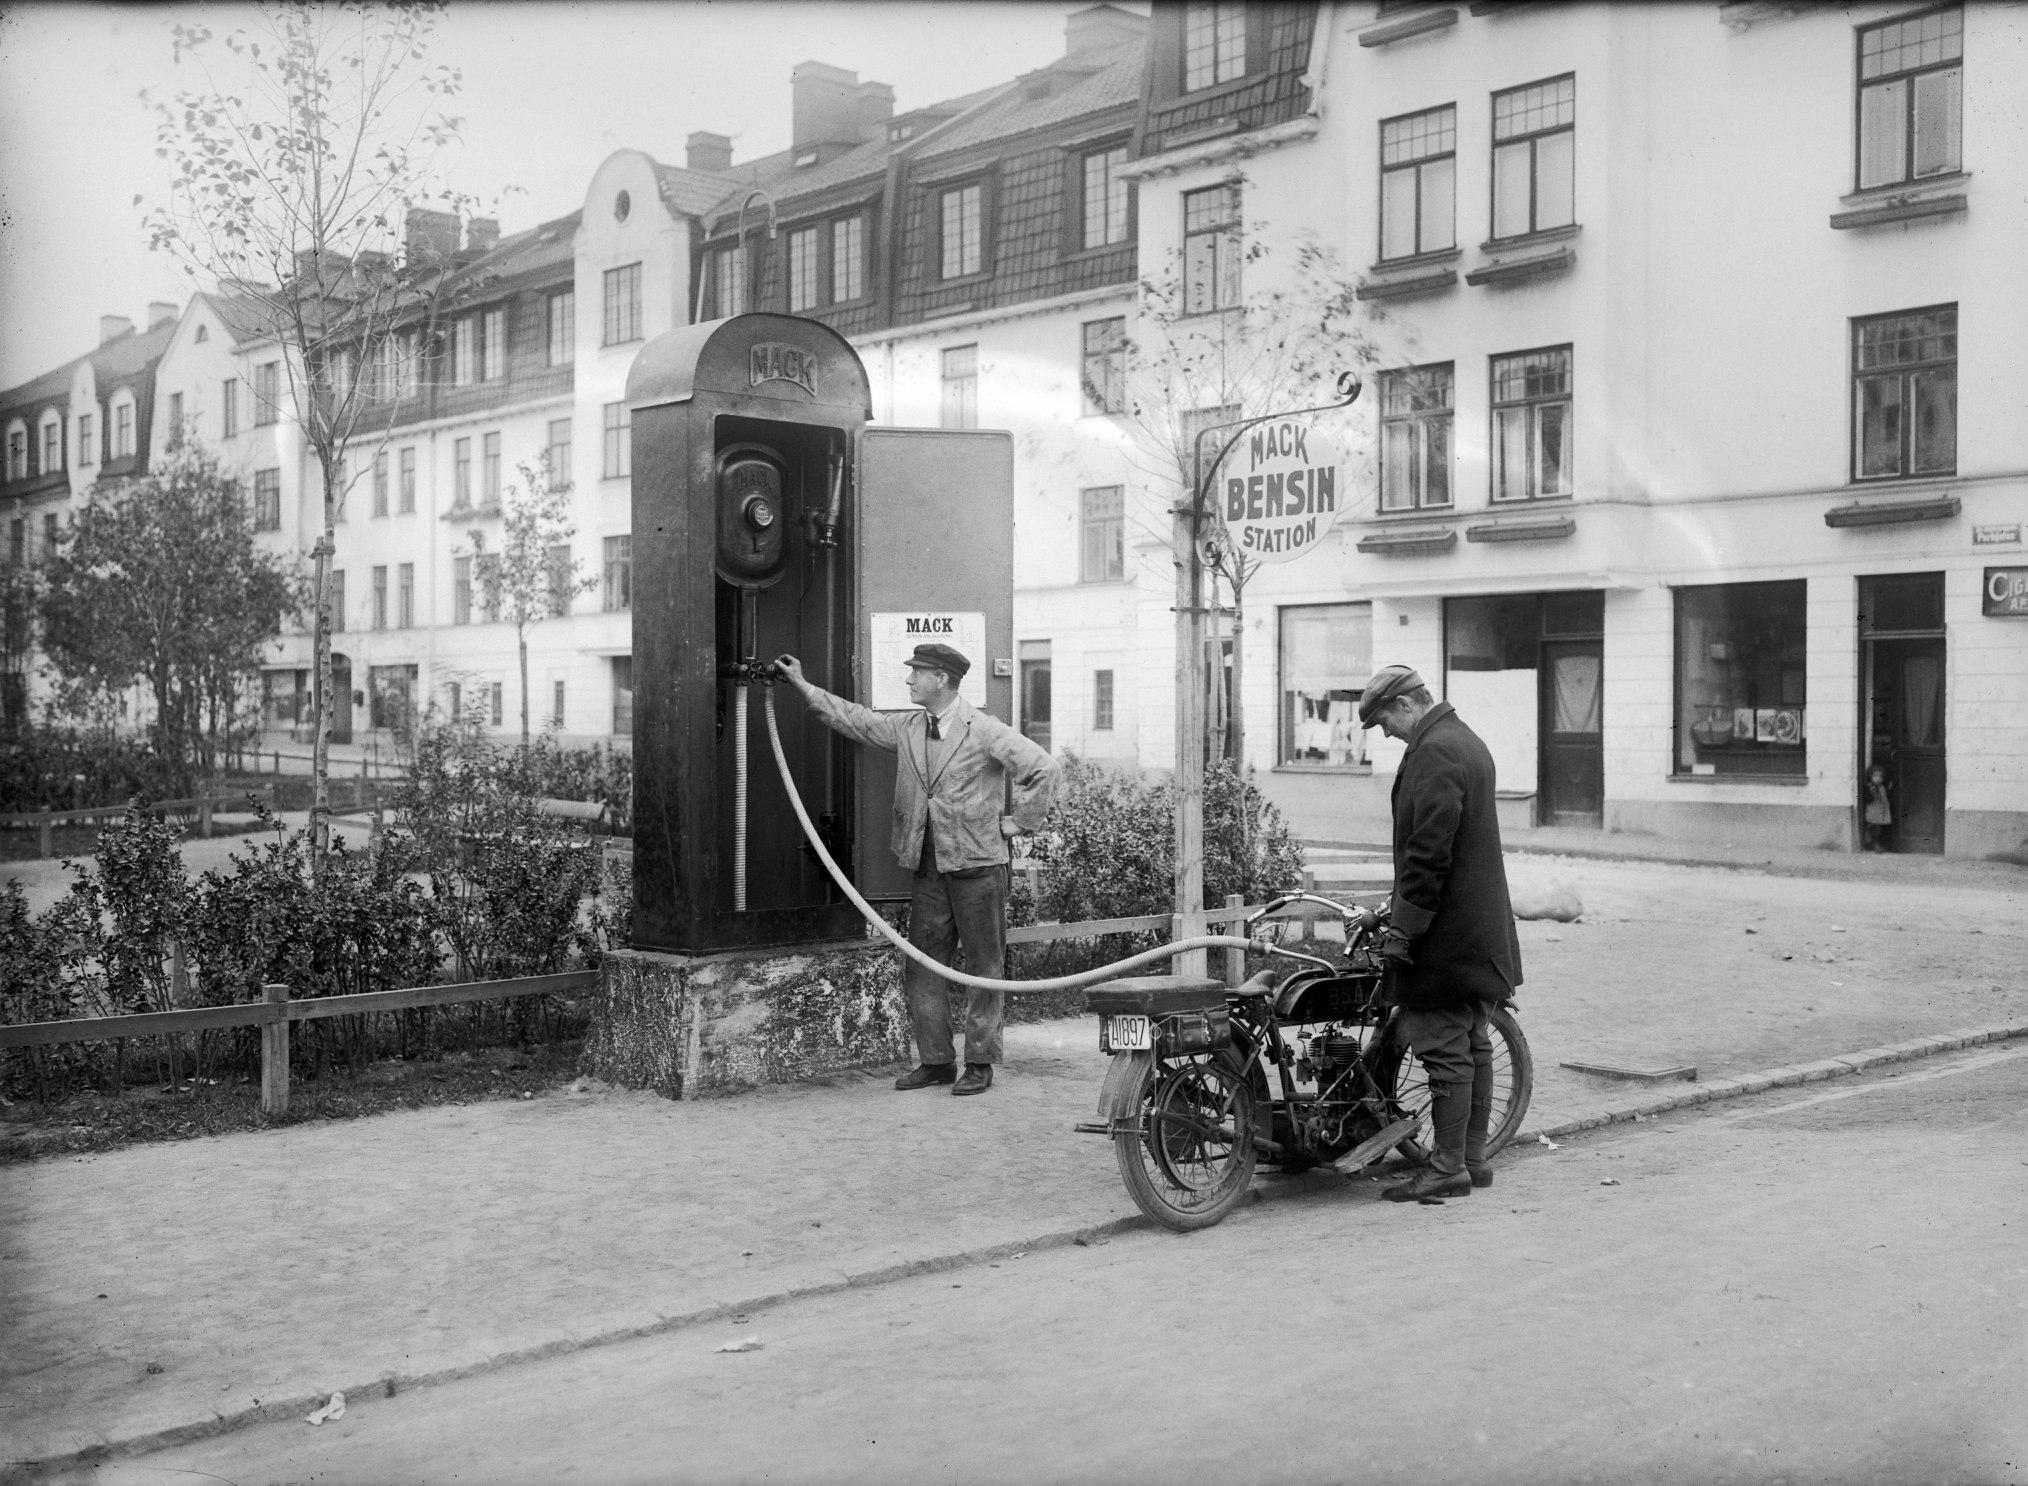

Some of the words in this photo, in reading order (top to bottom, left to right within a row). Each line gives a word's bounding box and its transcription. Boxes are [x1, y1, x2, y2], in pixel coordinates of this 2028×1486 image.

[752, 345, 815, 392] MACK
[1251, 423, 1309, 472] MACK
[1227, 466, 1335, 522] BENSIN
[1243, 517, 1316, 552] STATION
[1988, 572, 2028, 601] CIG
[906, 618, 953, 633] MACK
[1111, 1017, 1145, 1046] A1897
